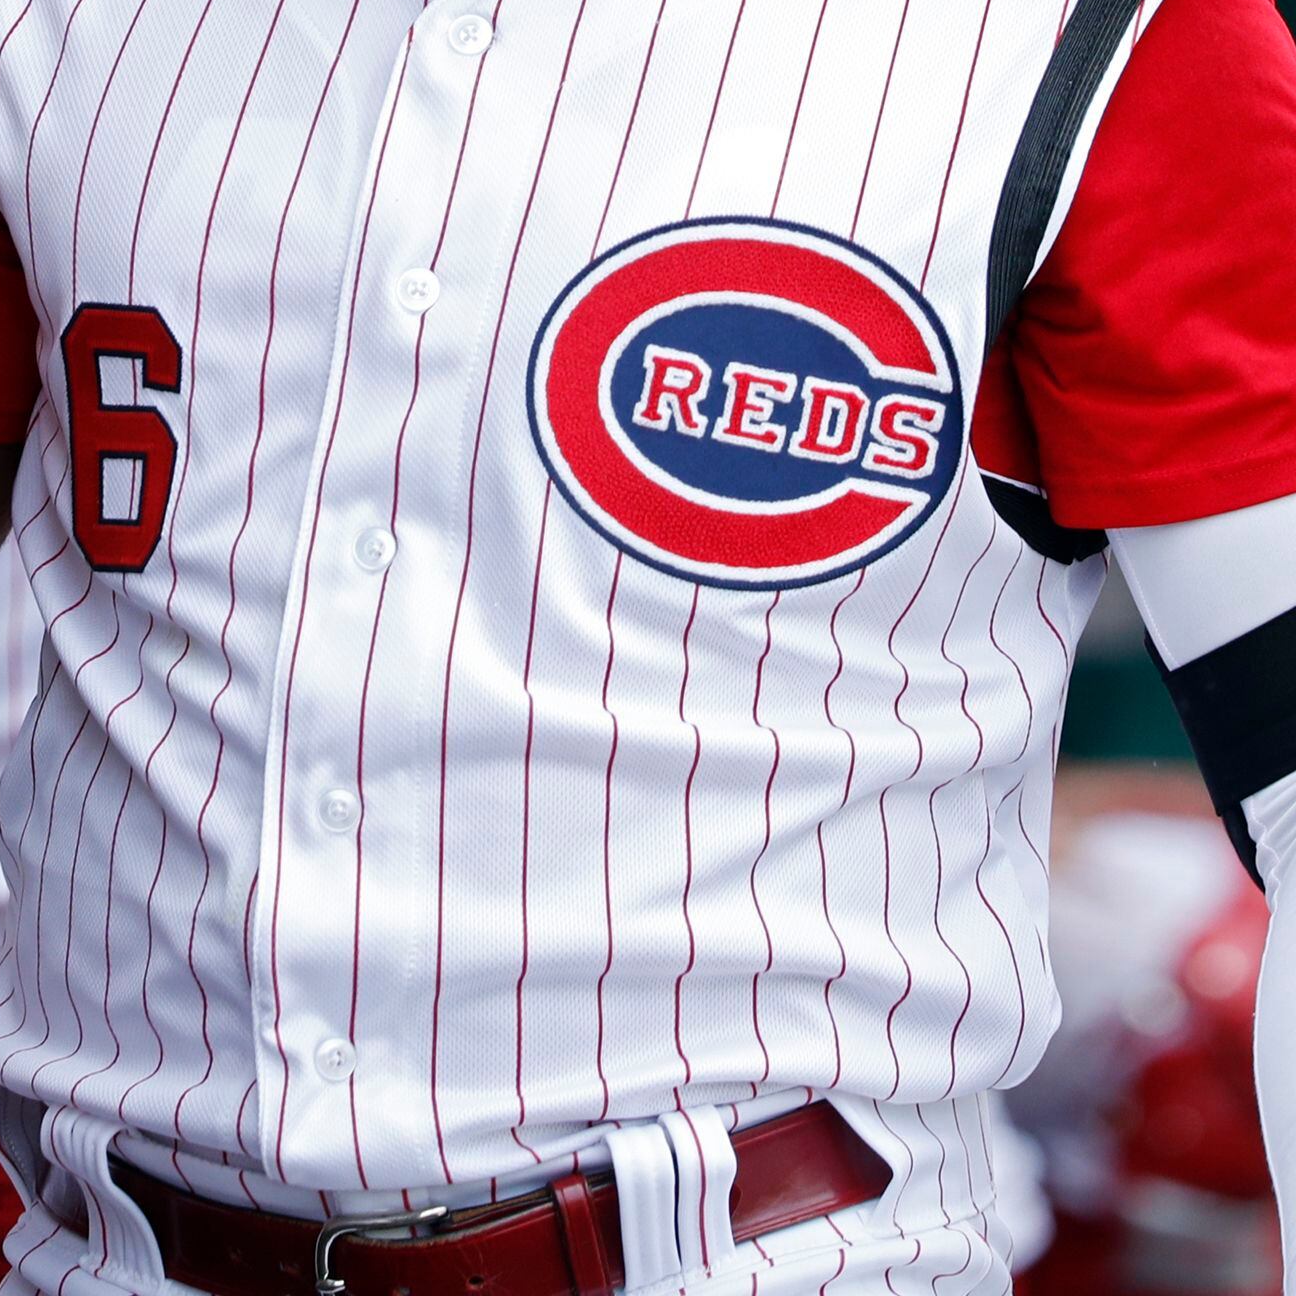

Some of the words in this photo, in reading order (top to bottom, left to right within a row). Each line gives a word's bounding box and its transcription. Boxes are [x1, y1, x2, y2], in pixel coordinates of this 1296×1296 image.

[60, 302, 183, 573] 6
[532, 222, 954, 582] C
[632, 344, 946, 480] REDS
